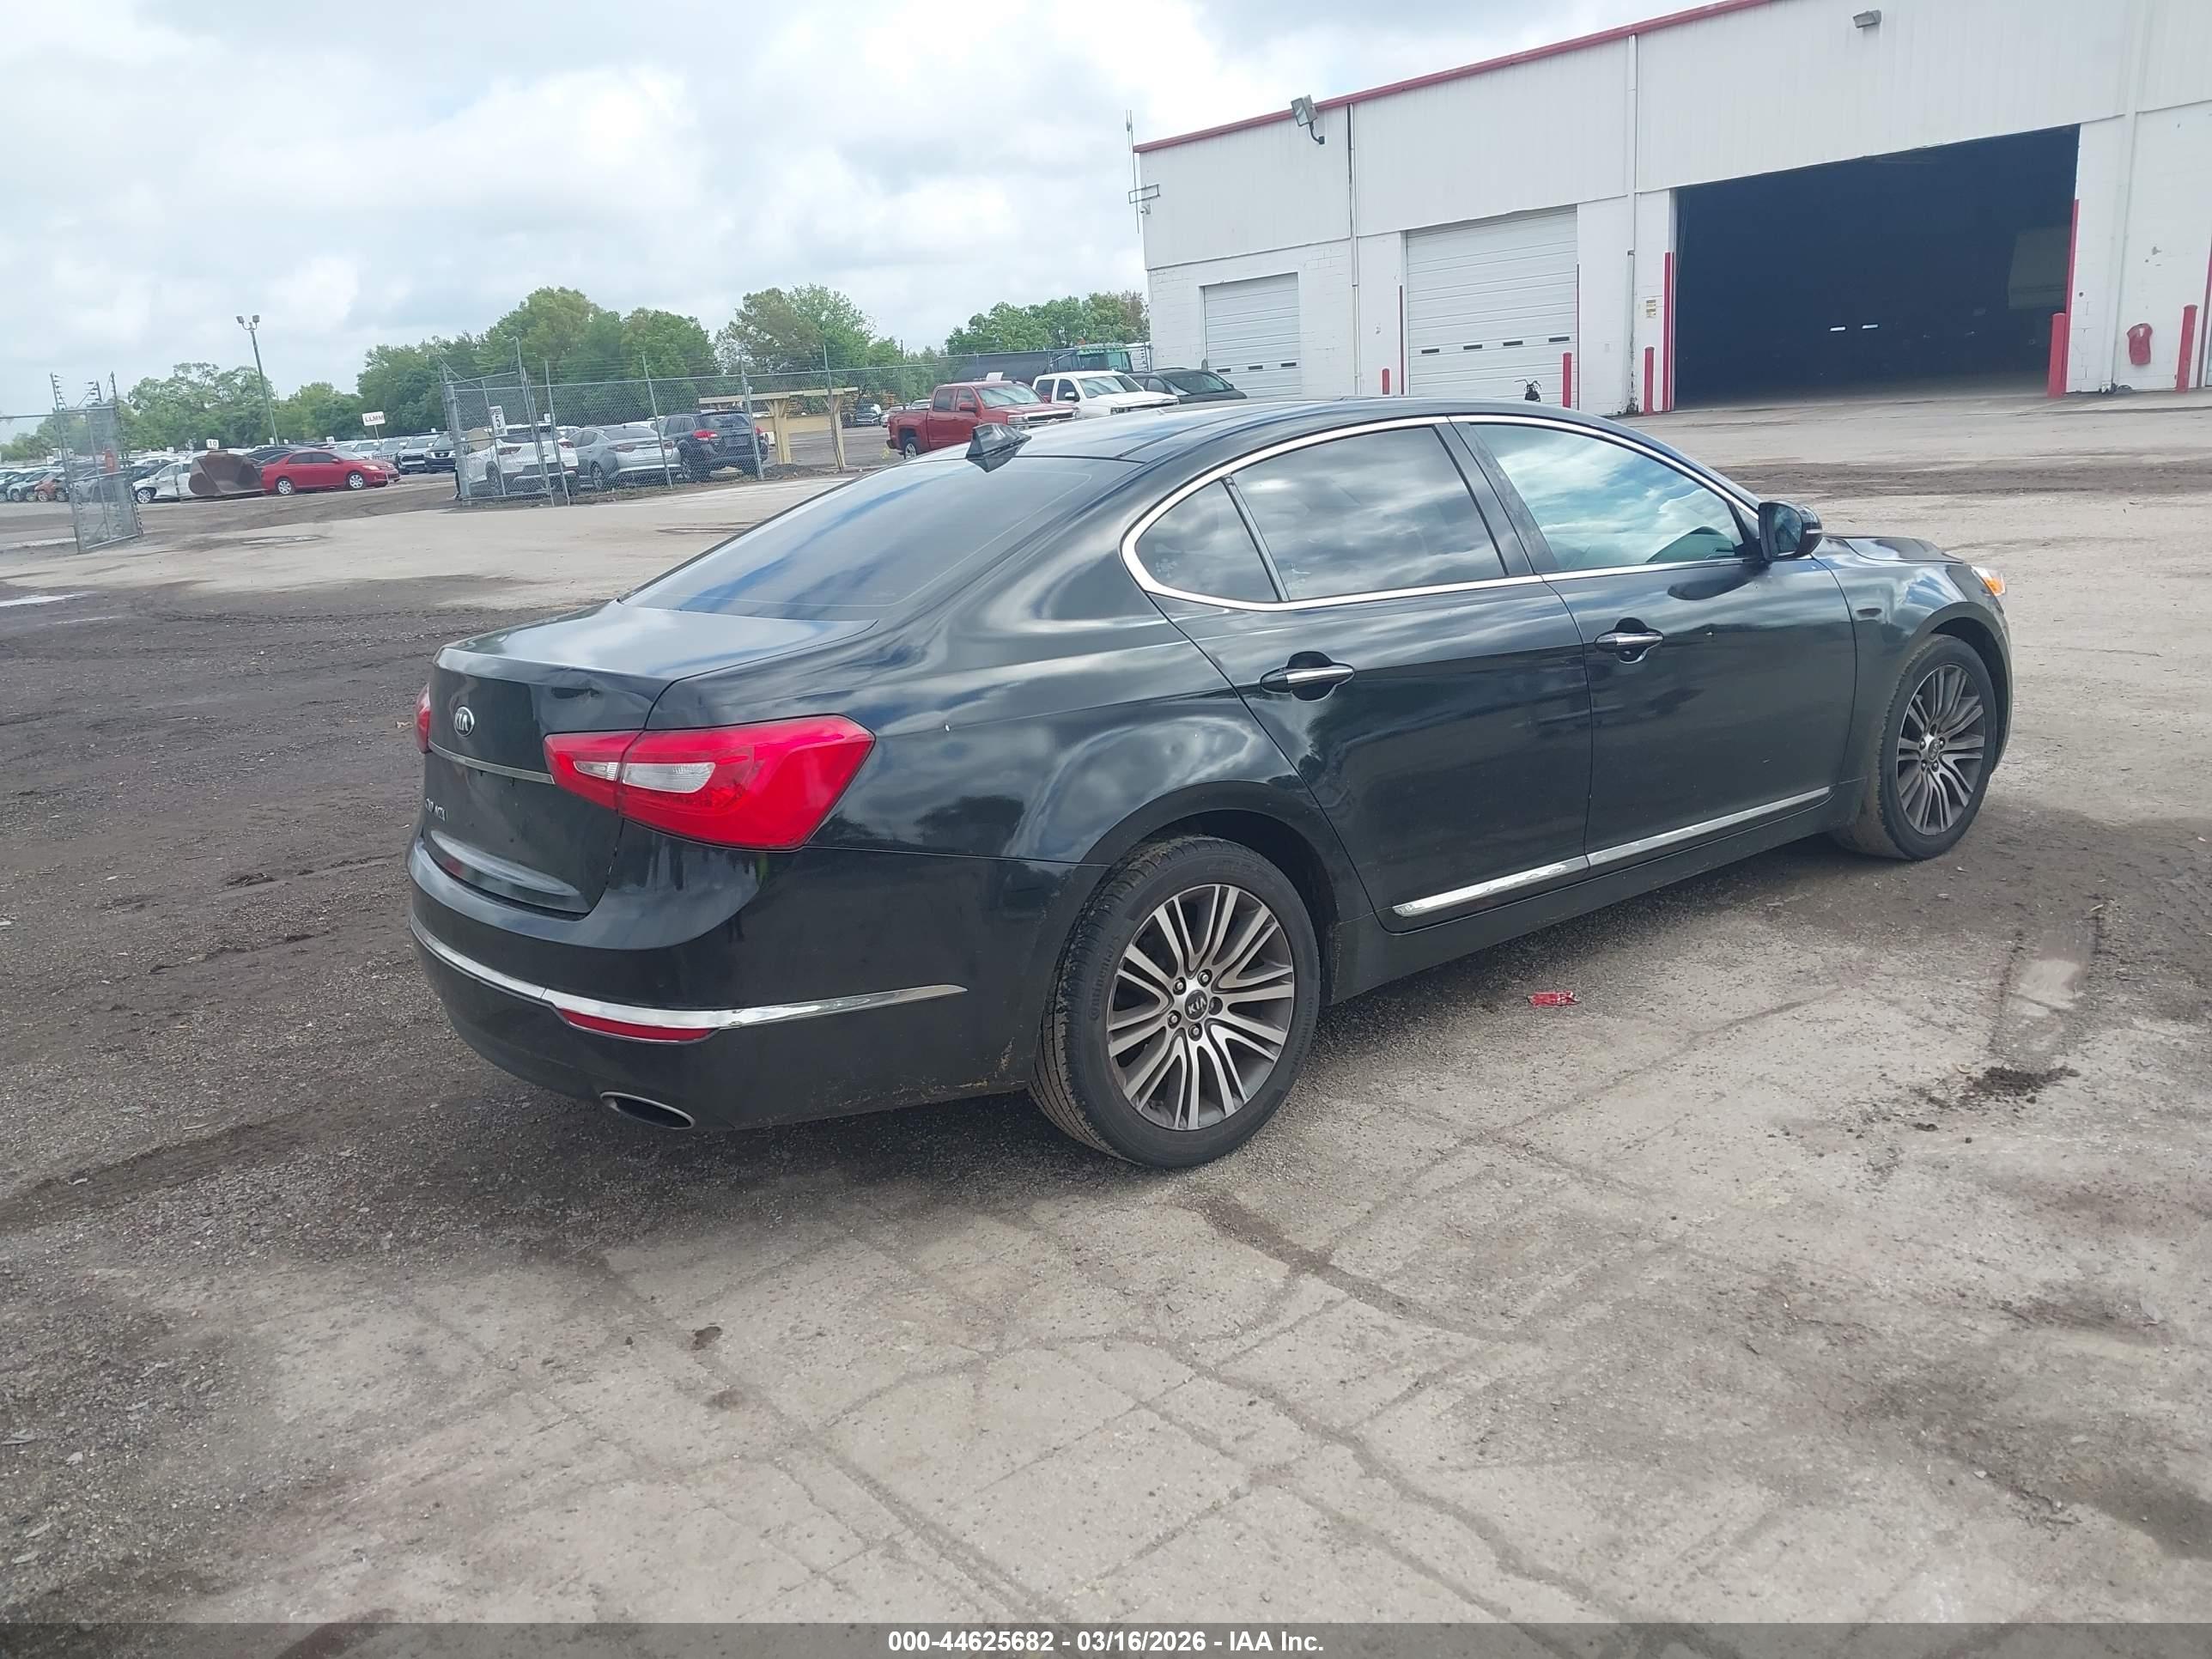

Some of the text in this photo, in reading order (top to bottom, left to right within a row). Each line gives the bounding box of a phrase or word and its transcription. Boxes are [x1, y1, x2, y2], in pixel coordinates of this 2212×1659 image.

[495, 415, 501, 428] 5
[455, 713, 469, 732] KIA
[1188, 996, 1206, 1014] KIA
